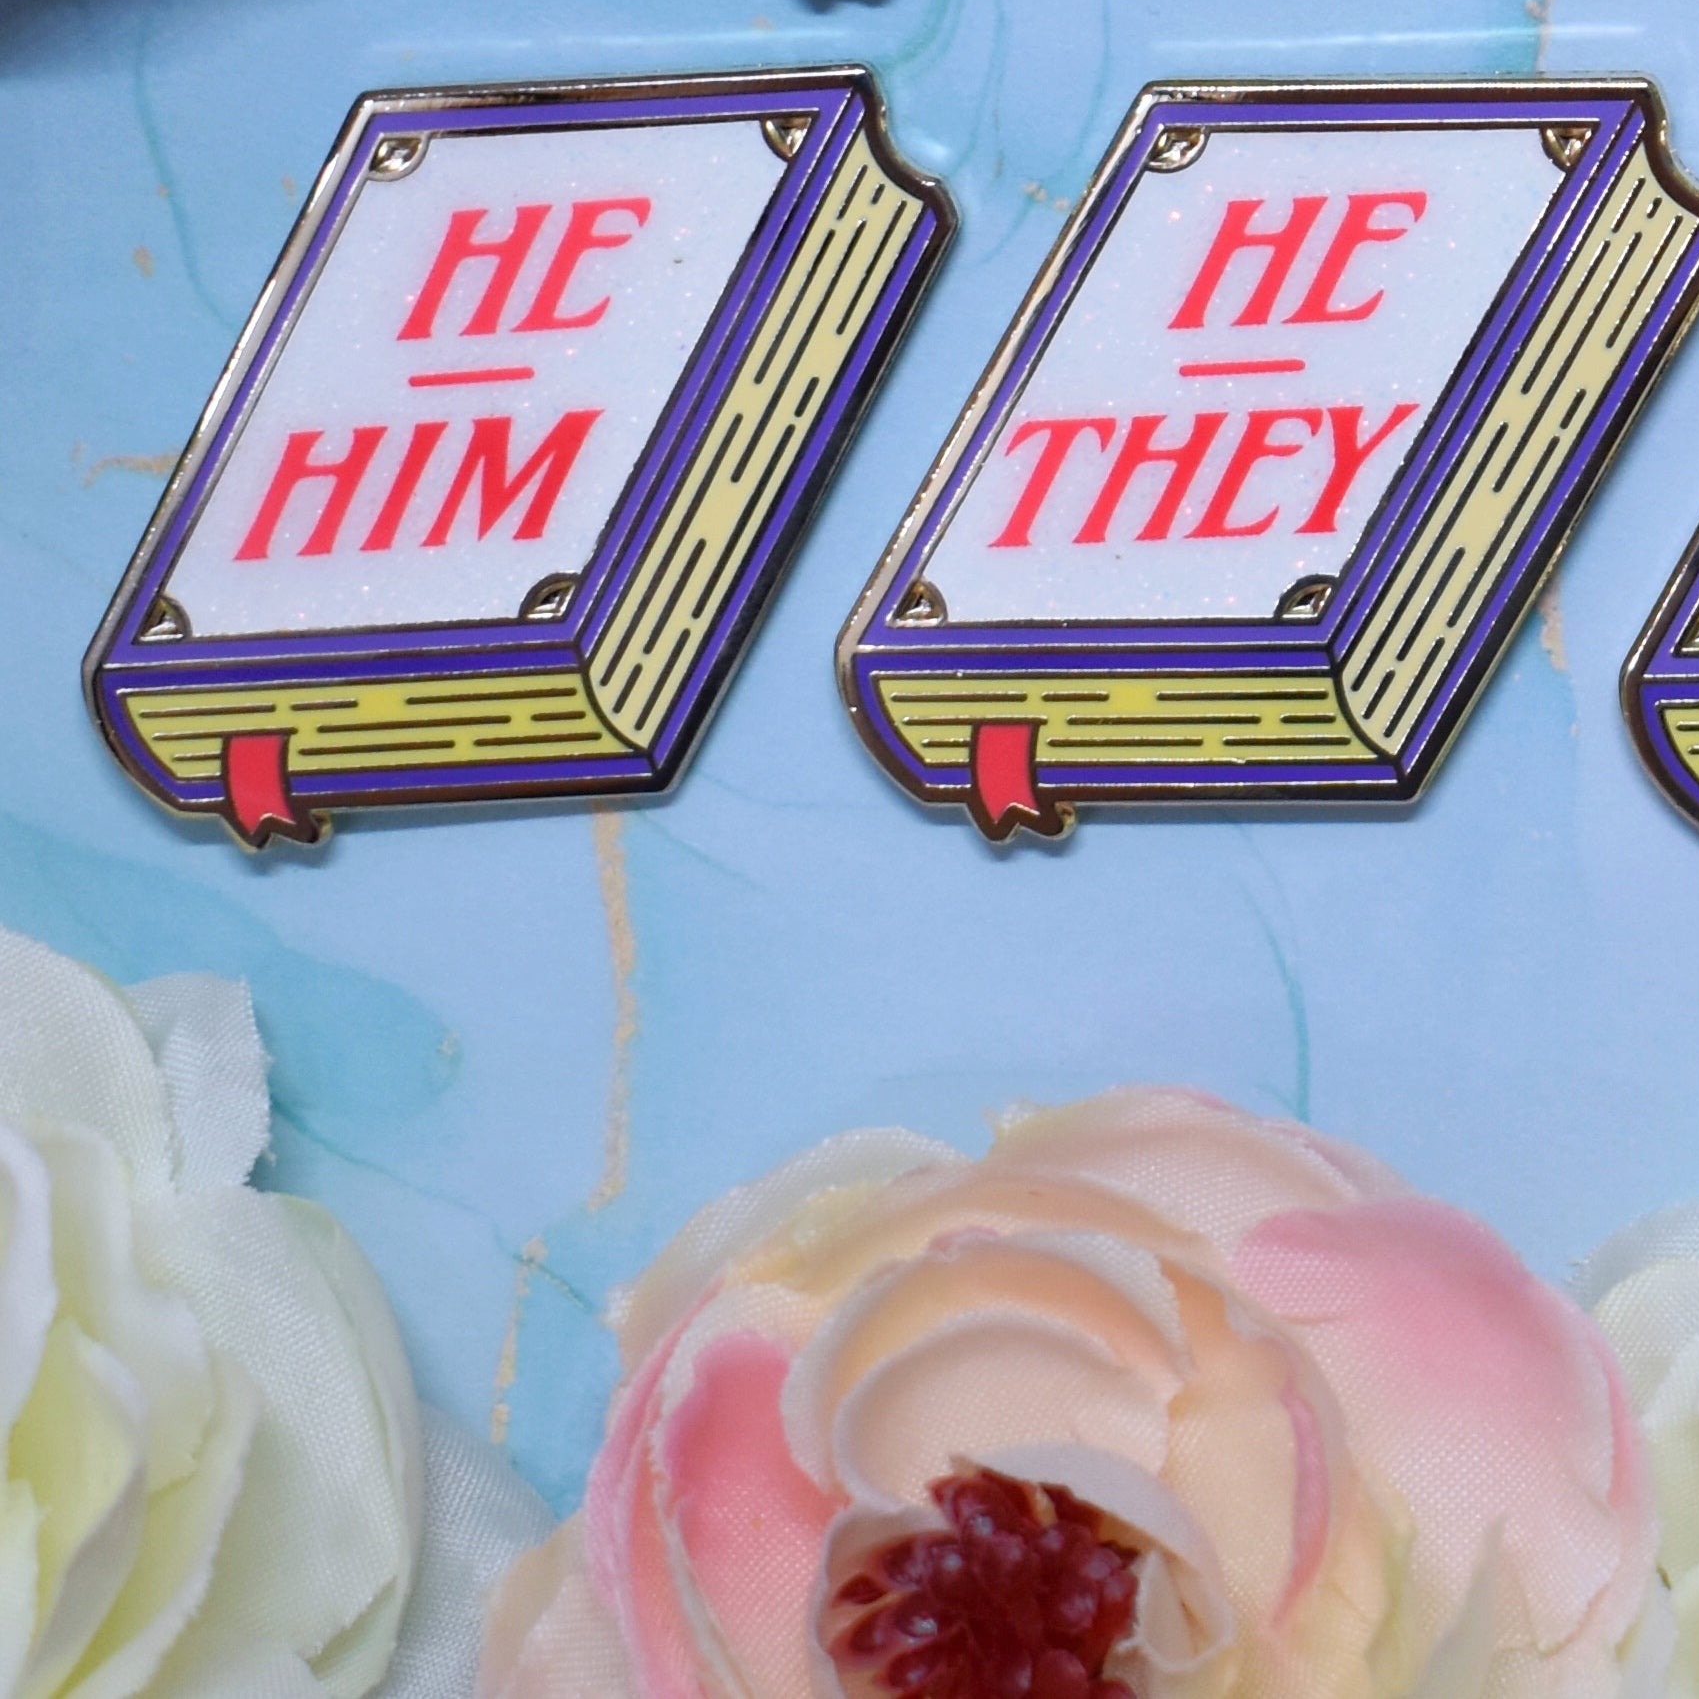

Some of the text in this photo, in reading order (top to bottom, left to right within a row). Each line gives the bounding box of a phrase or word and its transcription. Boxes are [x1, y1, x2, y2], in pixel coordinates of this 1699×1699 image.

[397, 196, 653, 342] HE
[1169, 190, 1429, 331] HE
[235, 408, 604, 563] HIM
[991, 402, 1420, 549] THEY
